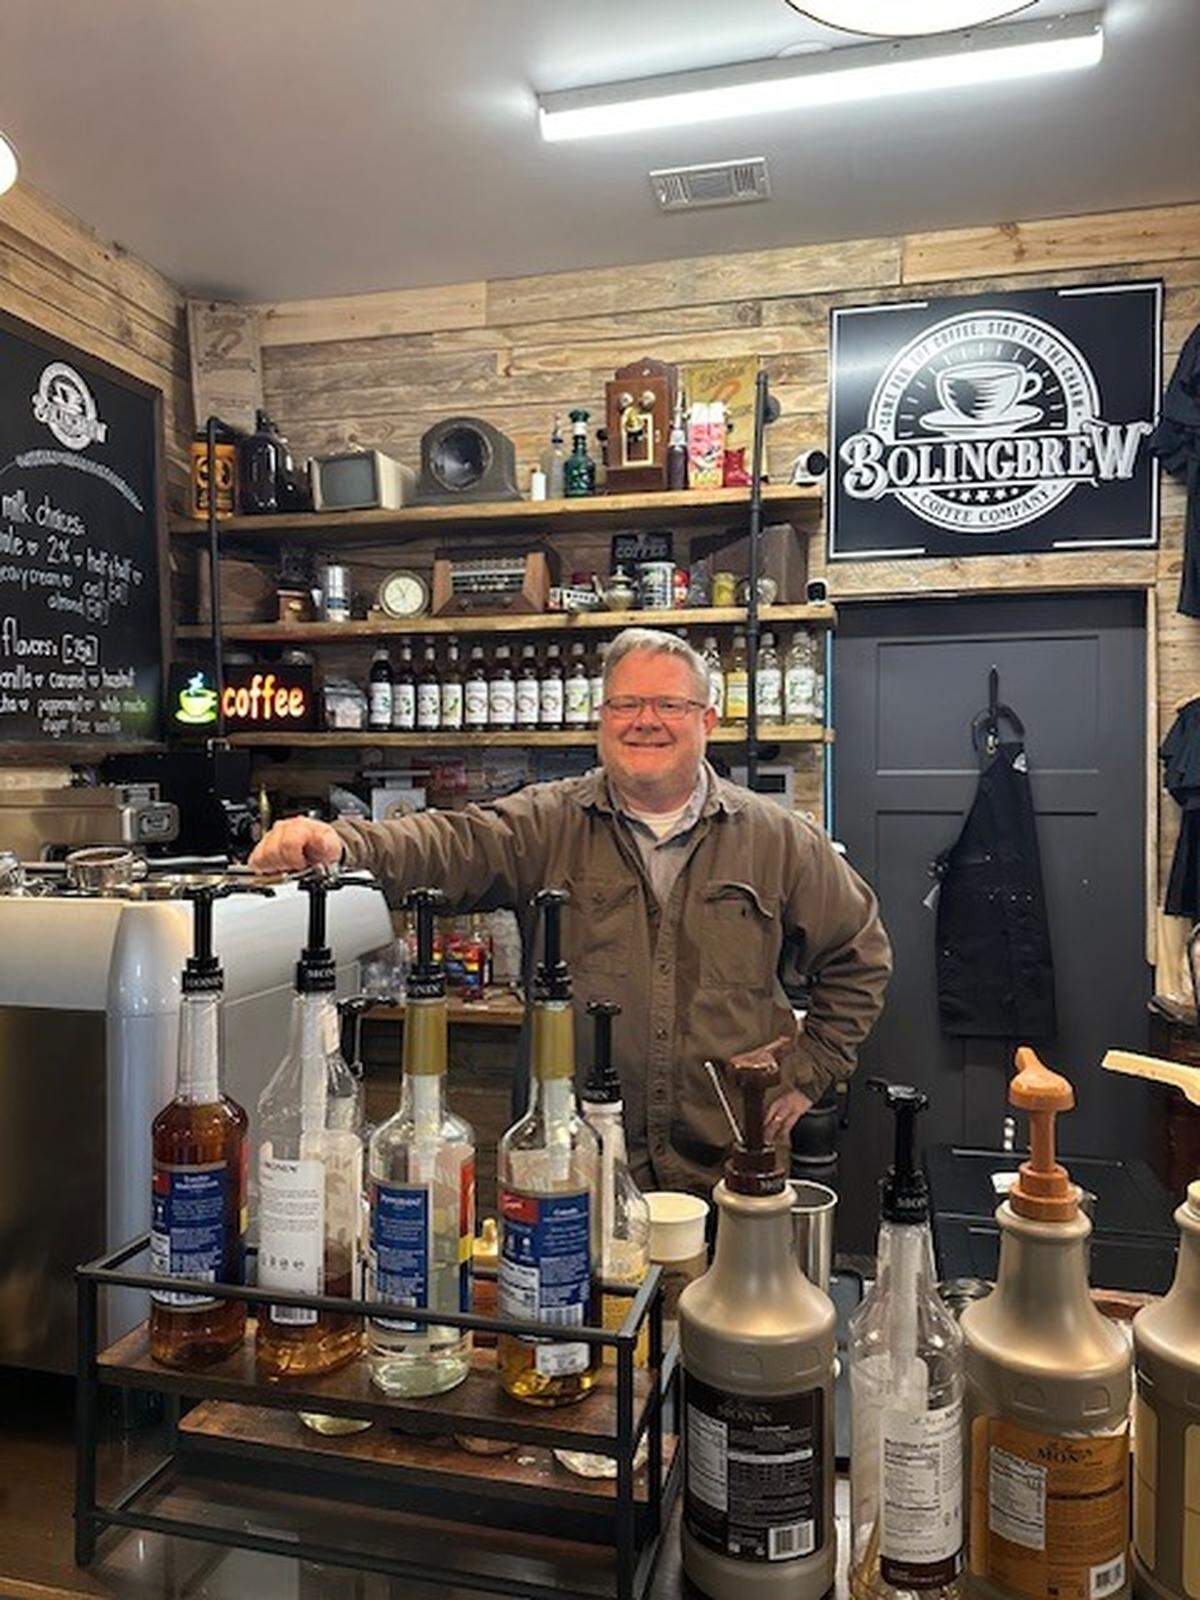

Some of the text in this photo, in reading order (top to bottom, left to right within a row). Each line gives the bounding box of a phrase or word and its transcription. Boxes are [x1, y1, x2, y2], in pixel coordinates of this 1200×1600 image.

[839, 419, 1154, 500] BOLINGBREW
[920, 489, 1050, 523] COFFEE COMPANY
[222, 674, 305, 719] coffee
